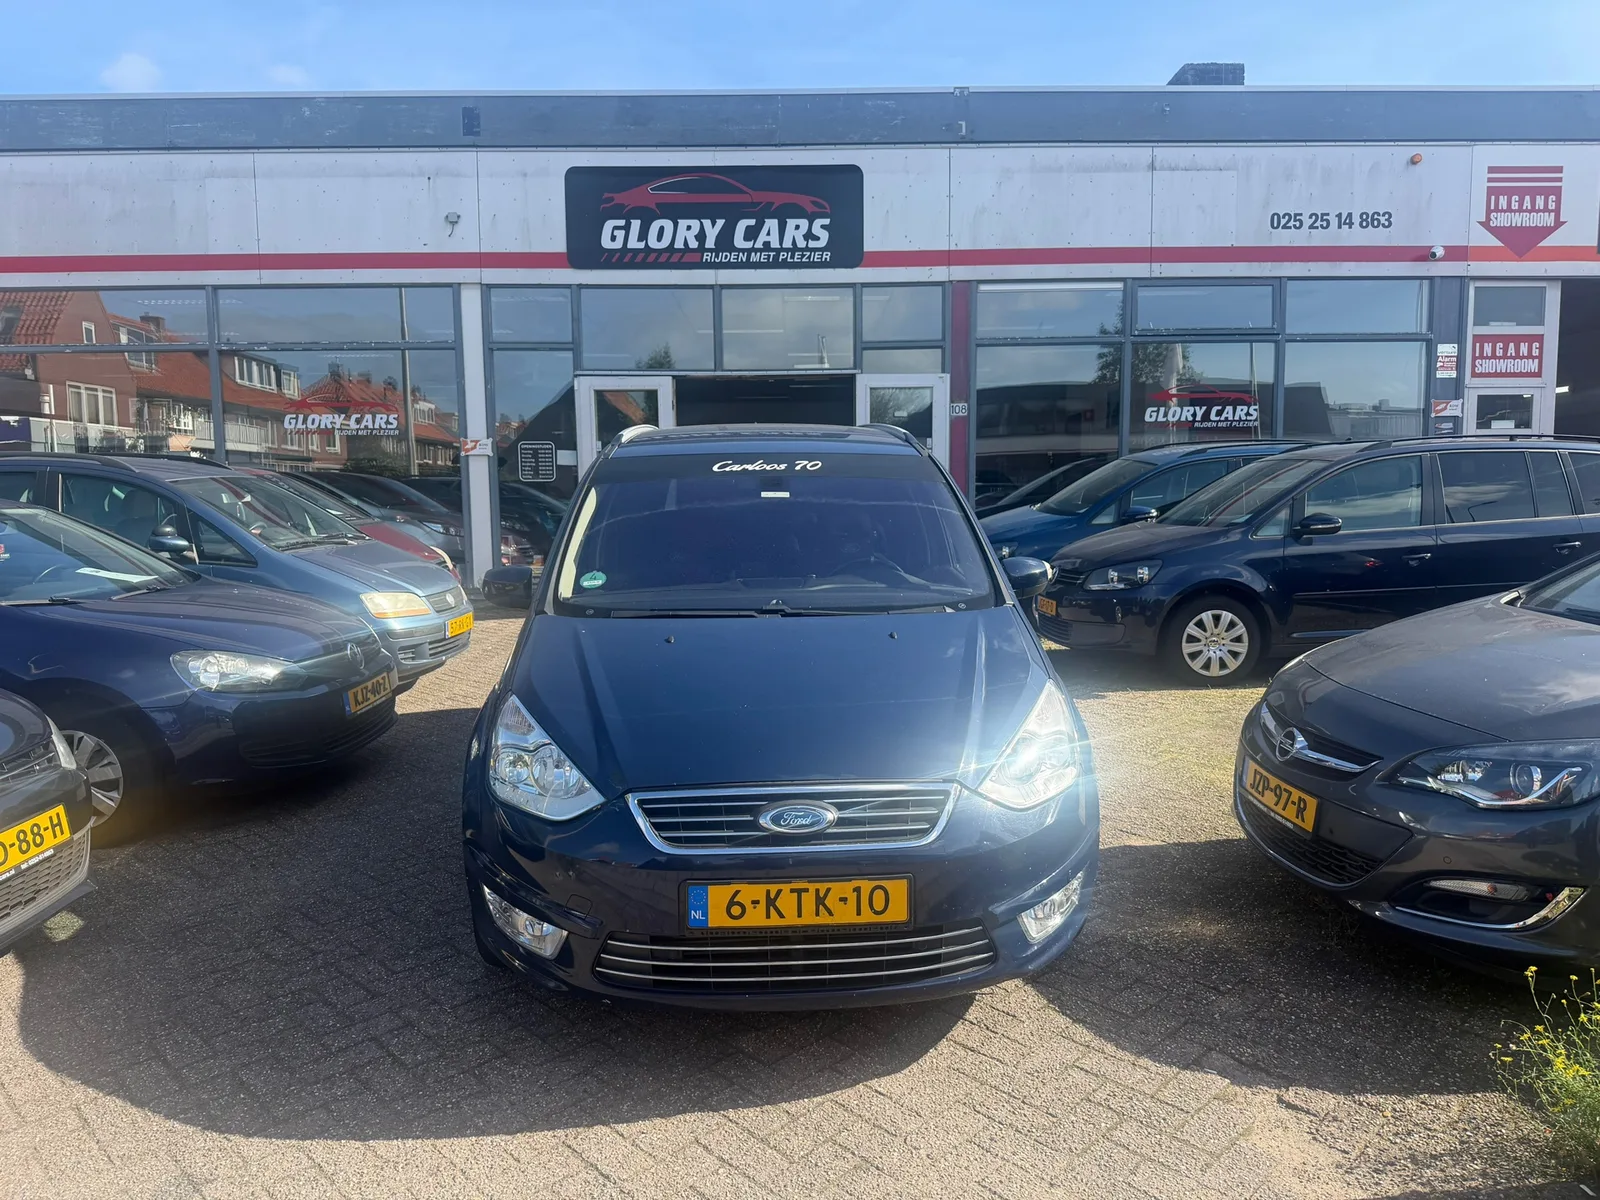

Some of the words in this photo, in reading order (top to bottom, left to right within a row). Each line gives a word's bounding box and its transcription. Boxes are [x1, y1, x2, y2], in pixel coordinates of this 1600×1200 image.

[1490, 195, 1556, 210] INGANG
[1269, 212, 1304, 230] 025
[1308, 212, 1331, 230] 25
[1335, 212, 1355, 229] 14
[1359, 211, 1393, 229] 863
[1489, 212, 1555, 227] SHOWROOM
[600, 218, 726, 249] GLORY
[733, 218, 831, 249] CARS
[702, 252, 747, 263] RIJDEN
[750, 252, 777, 262] MET
[779, 251, 831, 262] PLEZIER
[1475, 342, 1540, 357] INGANG
[1475, 359, 1539, 373] SHOWROOM
[951, 404, 967, 415] 108
[1144, 406, 1207, 422] GLORY
[1209, 405, 1259, 421] CARS
[283, 413, 346, 429] GLORY
[349, 413, 399, 429] CARS
[794, 460, 822, 471] 70
[352, 675, 389, 708] KJZ-40-Z
[1249, 768, 1306, 824] JZP-97-R
[780, 811, 812, 828] Ford
[725, 884, 891, 921] 6-KTK-10
[691, 909, 706, 920] NL
